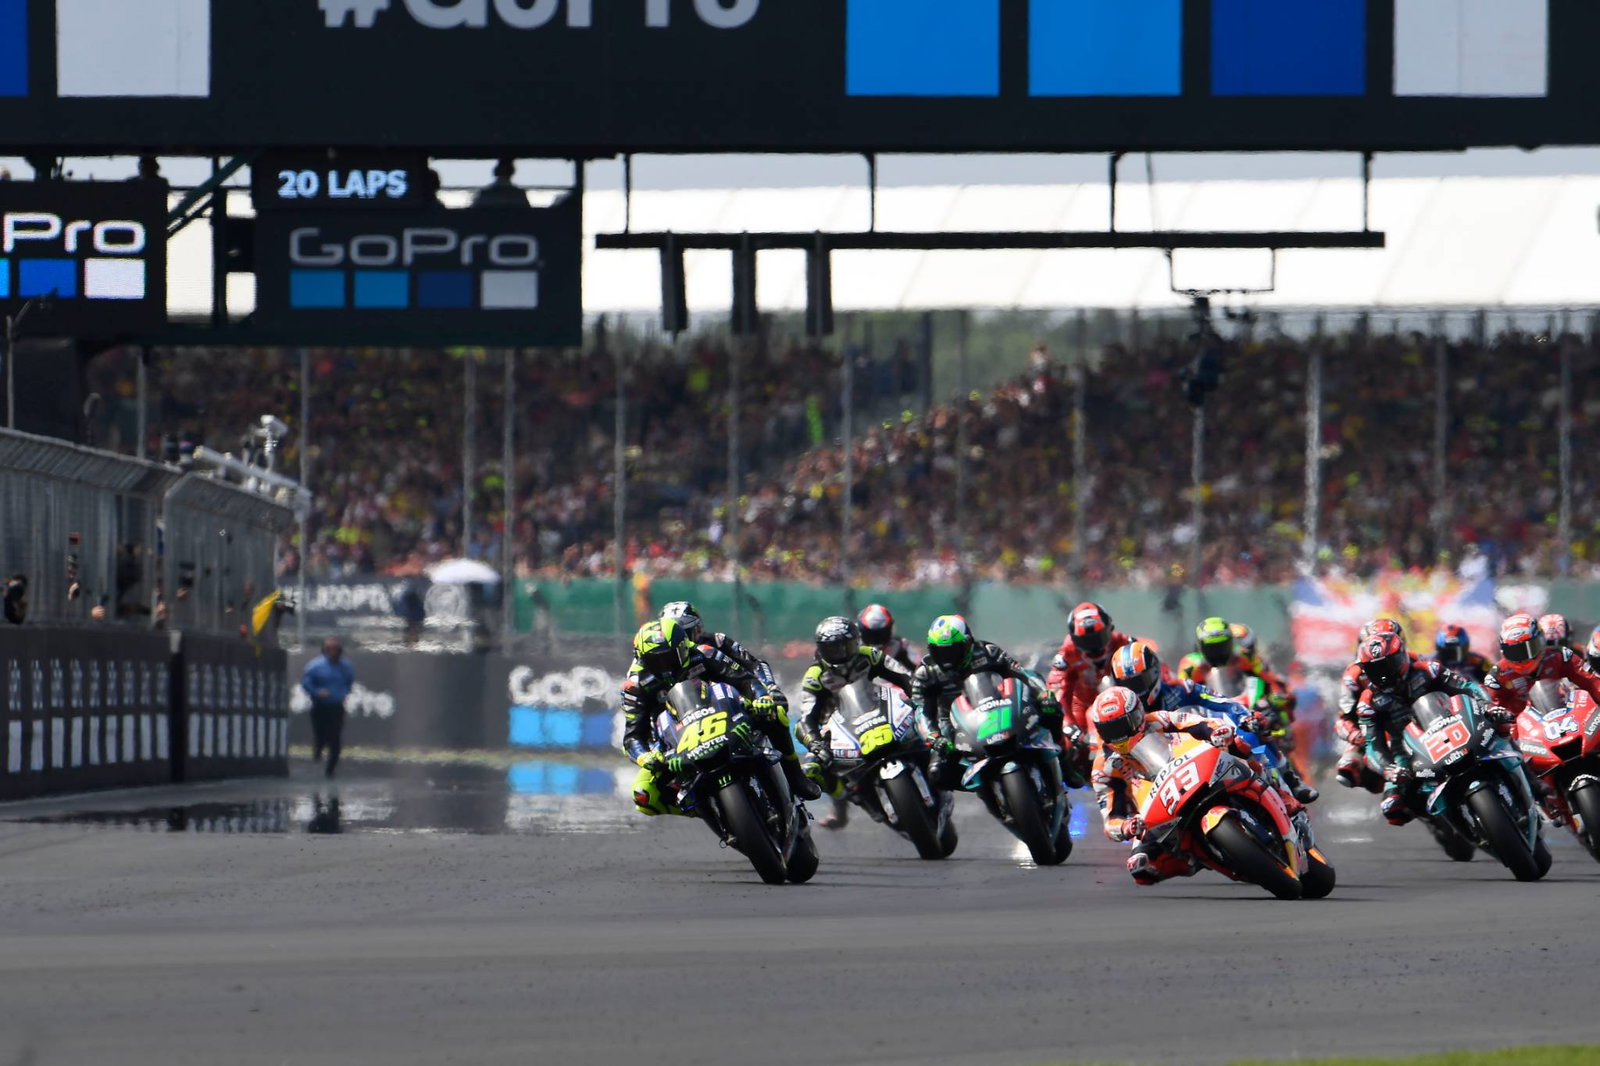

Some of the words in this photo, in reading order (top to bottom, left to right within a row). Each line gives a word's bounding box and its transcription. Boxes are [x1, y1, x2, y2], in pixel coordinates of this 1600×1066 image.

[277, 171, 318, 198] 20
[327, 171, 407, 199] LAPS
[3, 212, 146, 253] Pro
[289, 228, 538, 265] GoPro
[509, 665, 626, 707] GoP
[676, 711, 728, 754] 46
[859, 723, 893, 755] 35
[1543, 716, 1579, 740] 04
[1149, 754, 1190, 799] REPSOL
[1160, 761, 1200, 816] 93
